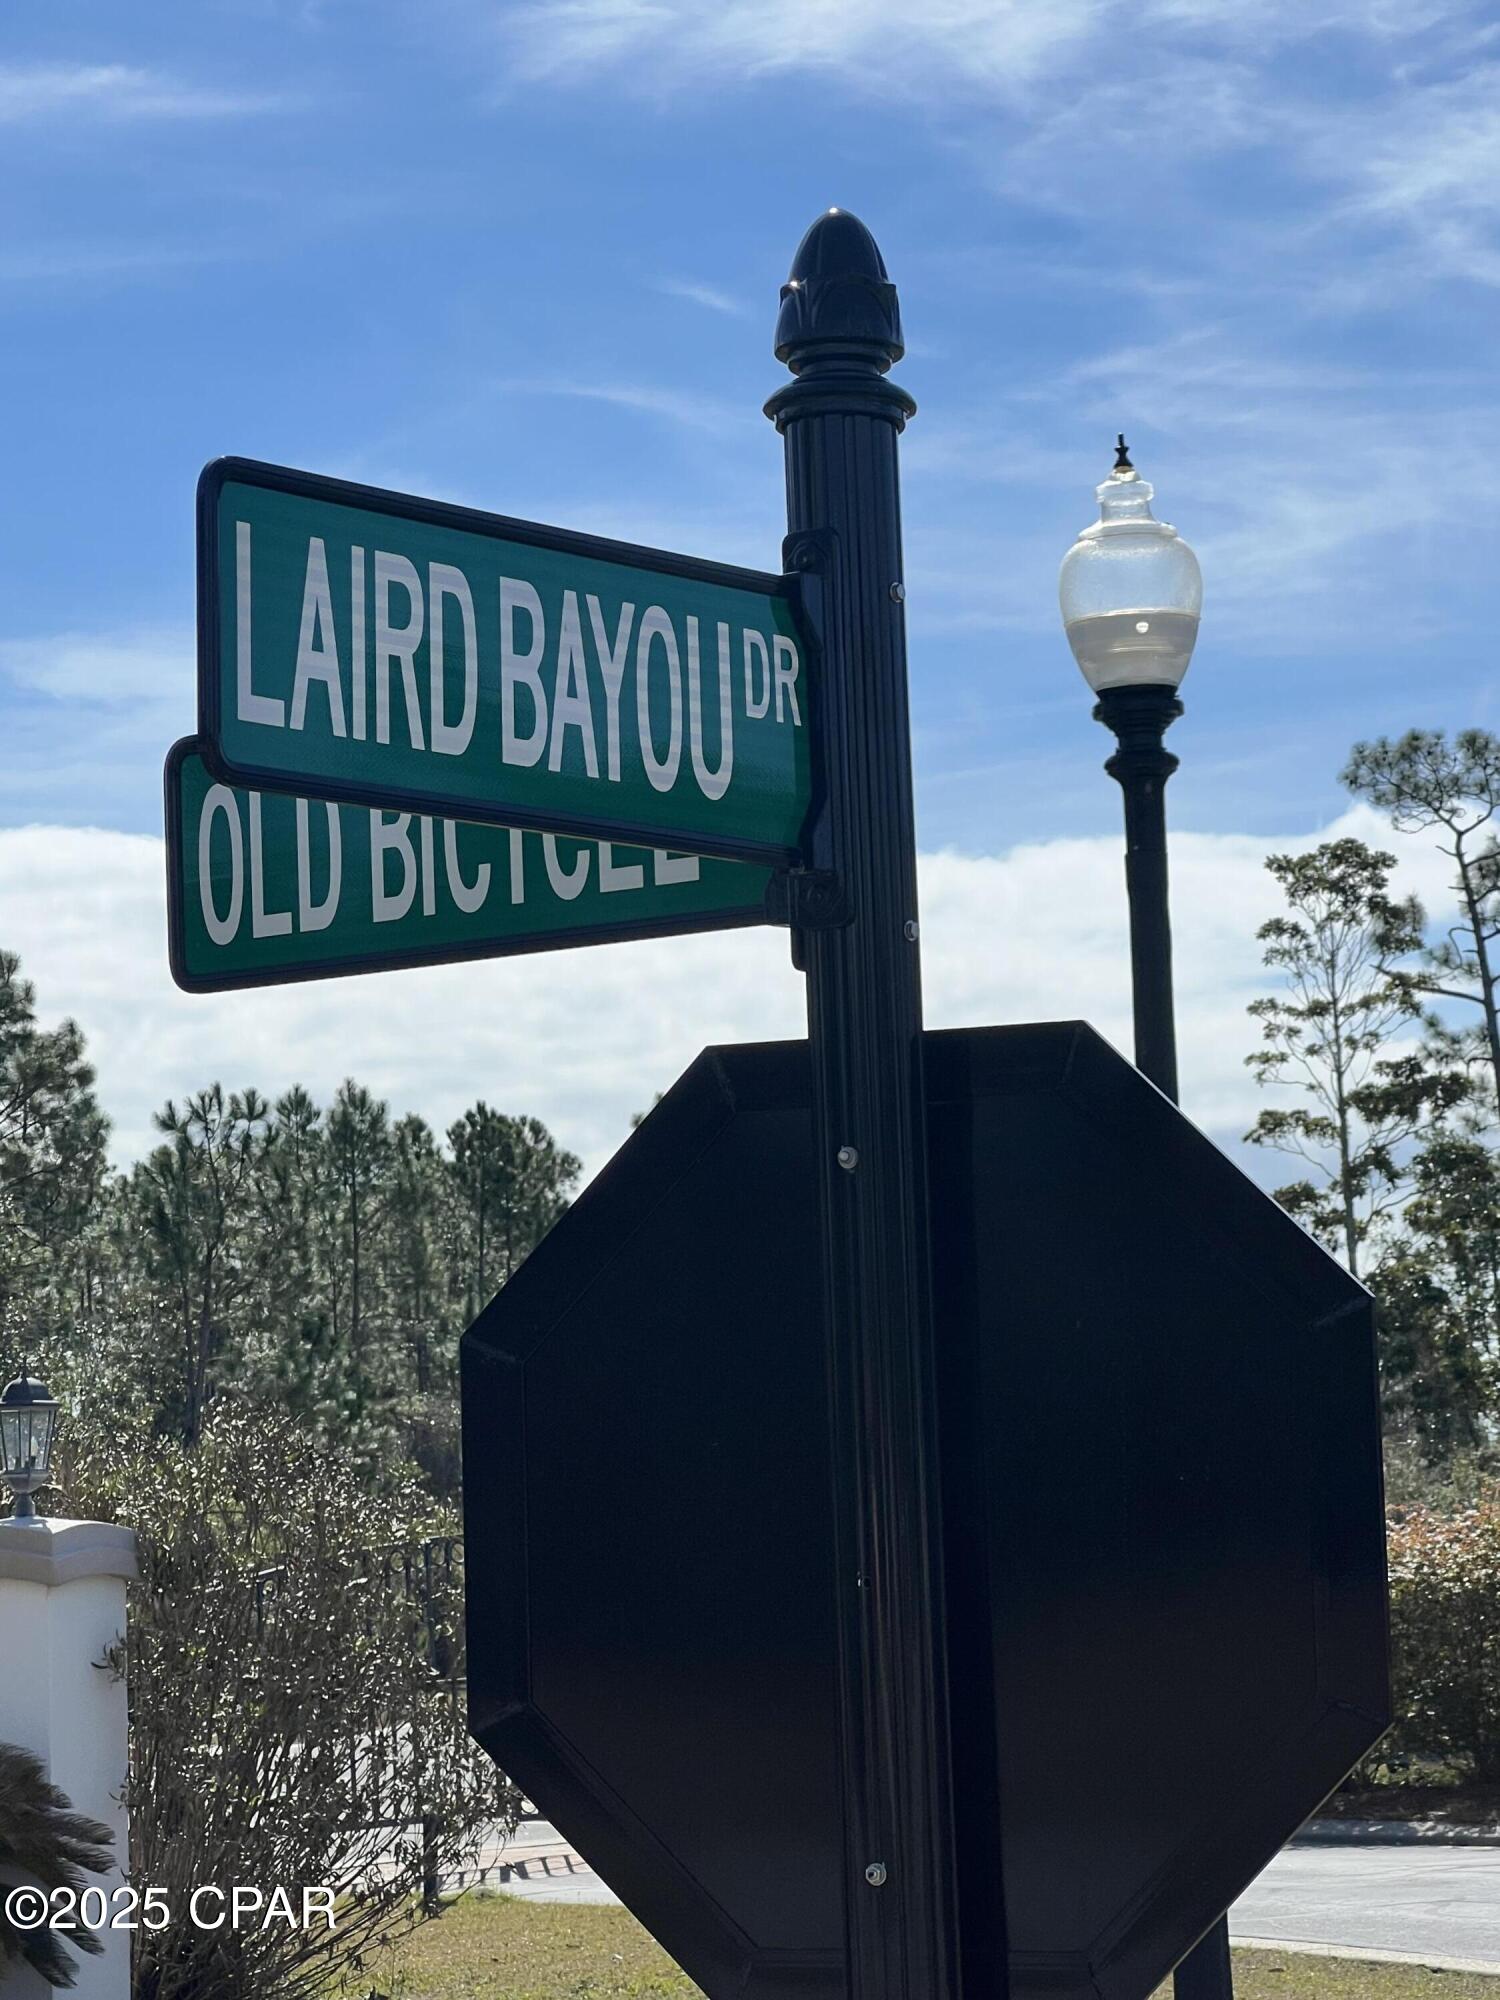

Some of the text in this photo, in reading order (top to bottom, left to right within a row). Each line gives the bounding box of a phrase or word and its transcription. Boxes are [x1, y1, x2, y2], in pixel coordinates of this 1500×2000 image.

[236, 520, 802, 800] LAIRD BAYOU DR
[198, 783, 342, 945] OLD
